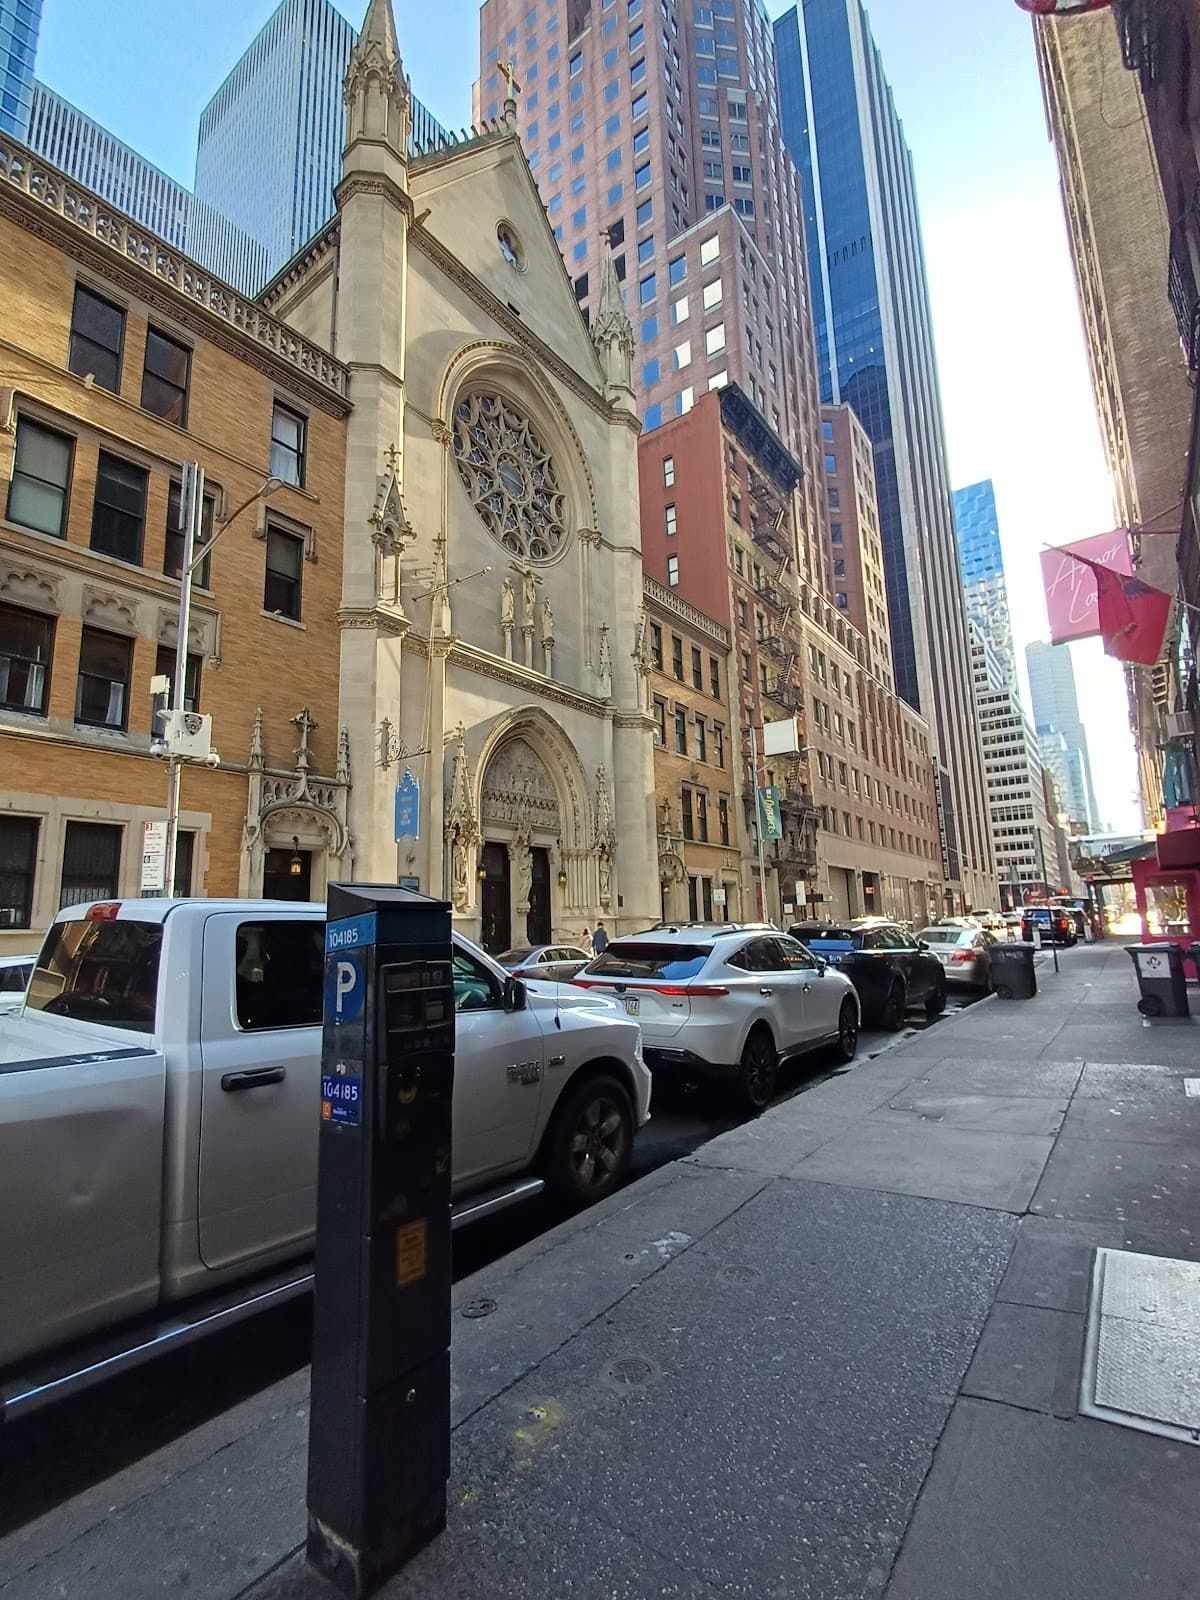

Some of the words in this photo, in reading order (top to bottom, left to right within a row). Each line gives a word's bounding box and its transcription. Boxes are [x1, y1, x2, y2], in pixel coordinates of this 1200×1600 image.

[329, 927, 359, 948] 104185
[336, 961, 357, 1013] P
[323, 1081, 358, 1101] 104185
